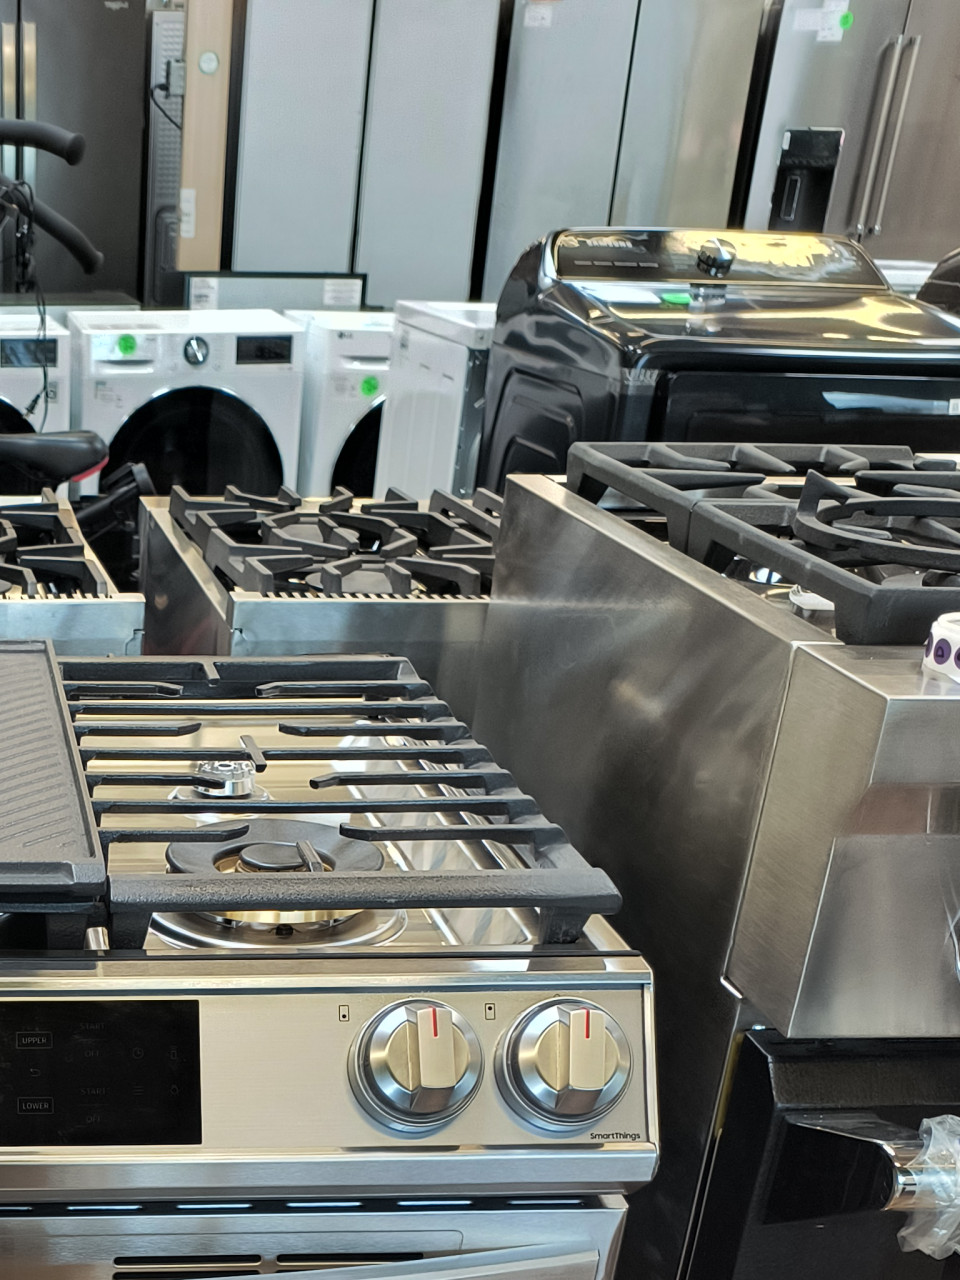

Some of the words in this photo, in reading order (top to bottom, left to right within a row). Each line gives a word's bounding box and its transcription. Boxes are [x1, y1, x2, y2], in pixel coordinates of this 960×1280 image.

[22, 1036, 47, 1044] UPPER
[23, 1102, 49, 1110] LOWER
[590, 1132, 640, 1141] SmartThings
